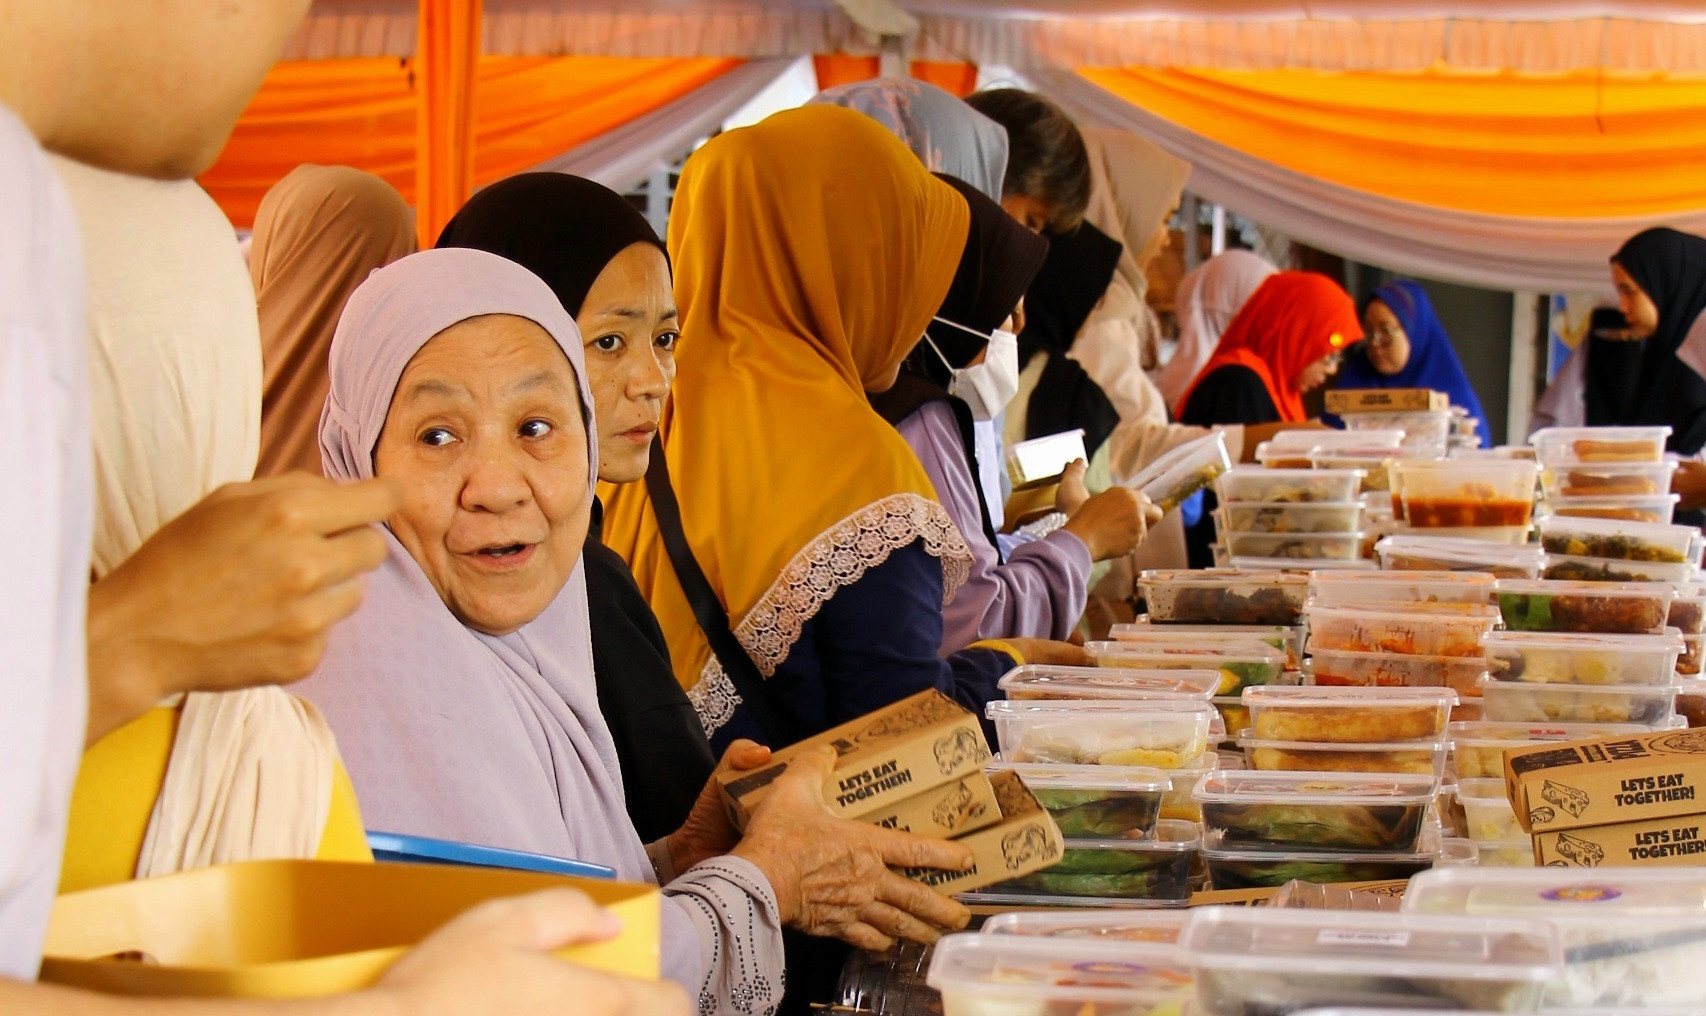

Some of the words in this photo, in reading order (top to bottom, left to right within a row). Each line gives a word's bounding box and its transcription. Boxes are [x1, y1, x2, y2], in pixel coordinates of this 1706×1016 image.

[838, 770, 872, 792] LETS
[872, 759, 897, 778] EAT
[1621, 777, 1655, 791] LETS
[1657, 773, 1684, 788] EAT
[836, 768, 912, 807] TOGETHER!
[1614, 785, 1694, 806] TOGETHER!
[874, 815, 898, 829] AT
[1635, 830, 1670, 845] LETS
[1672, 827, 1698, 841] EAT
